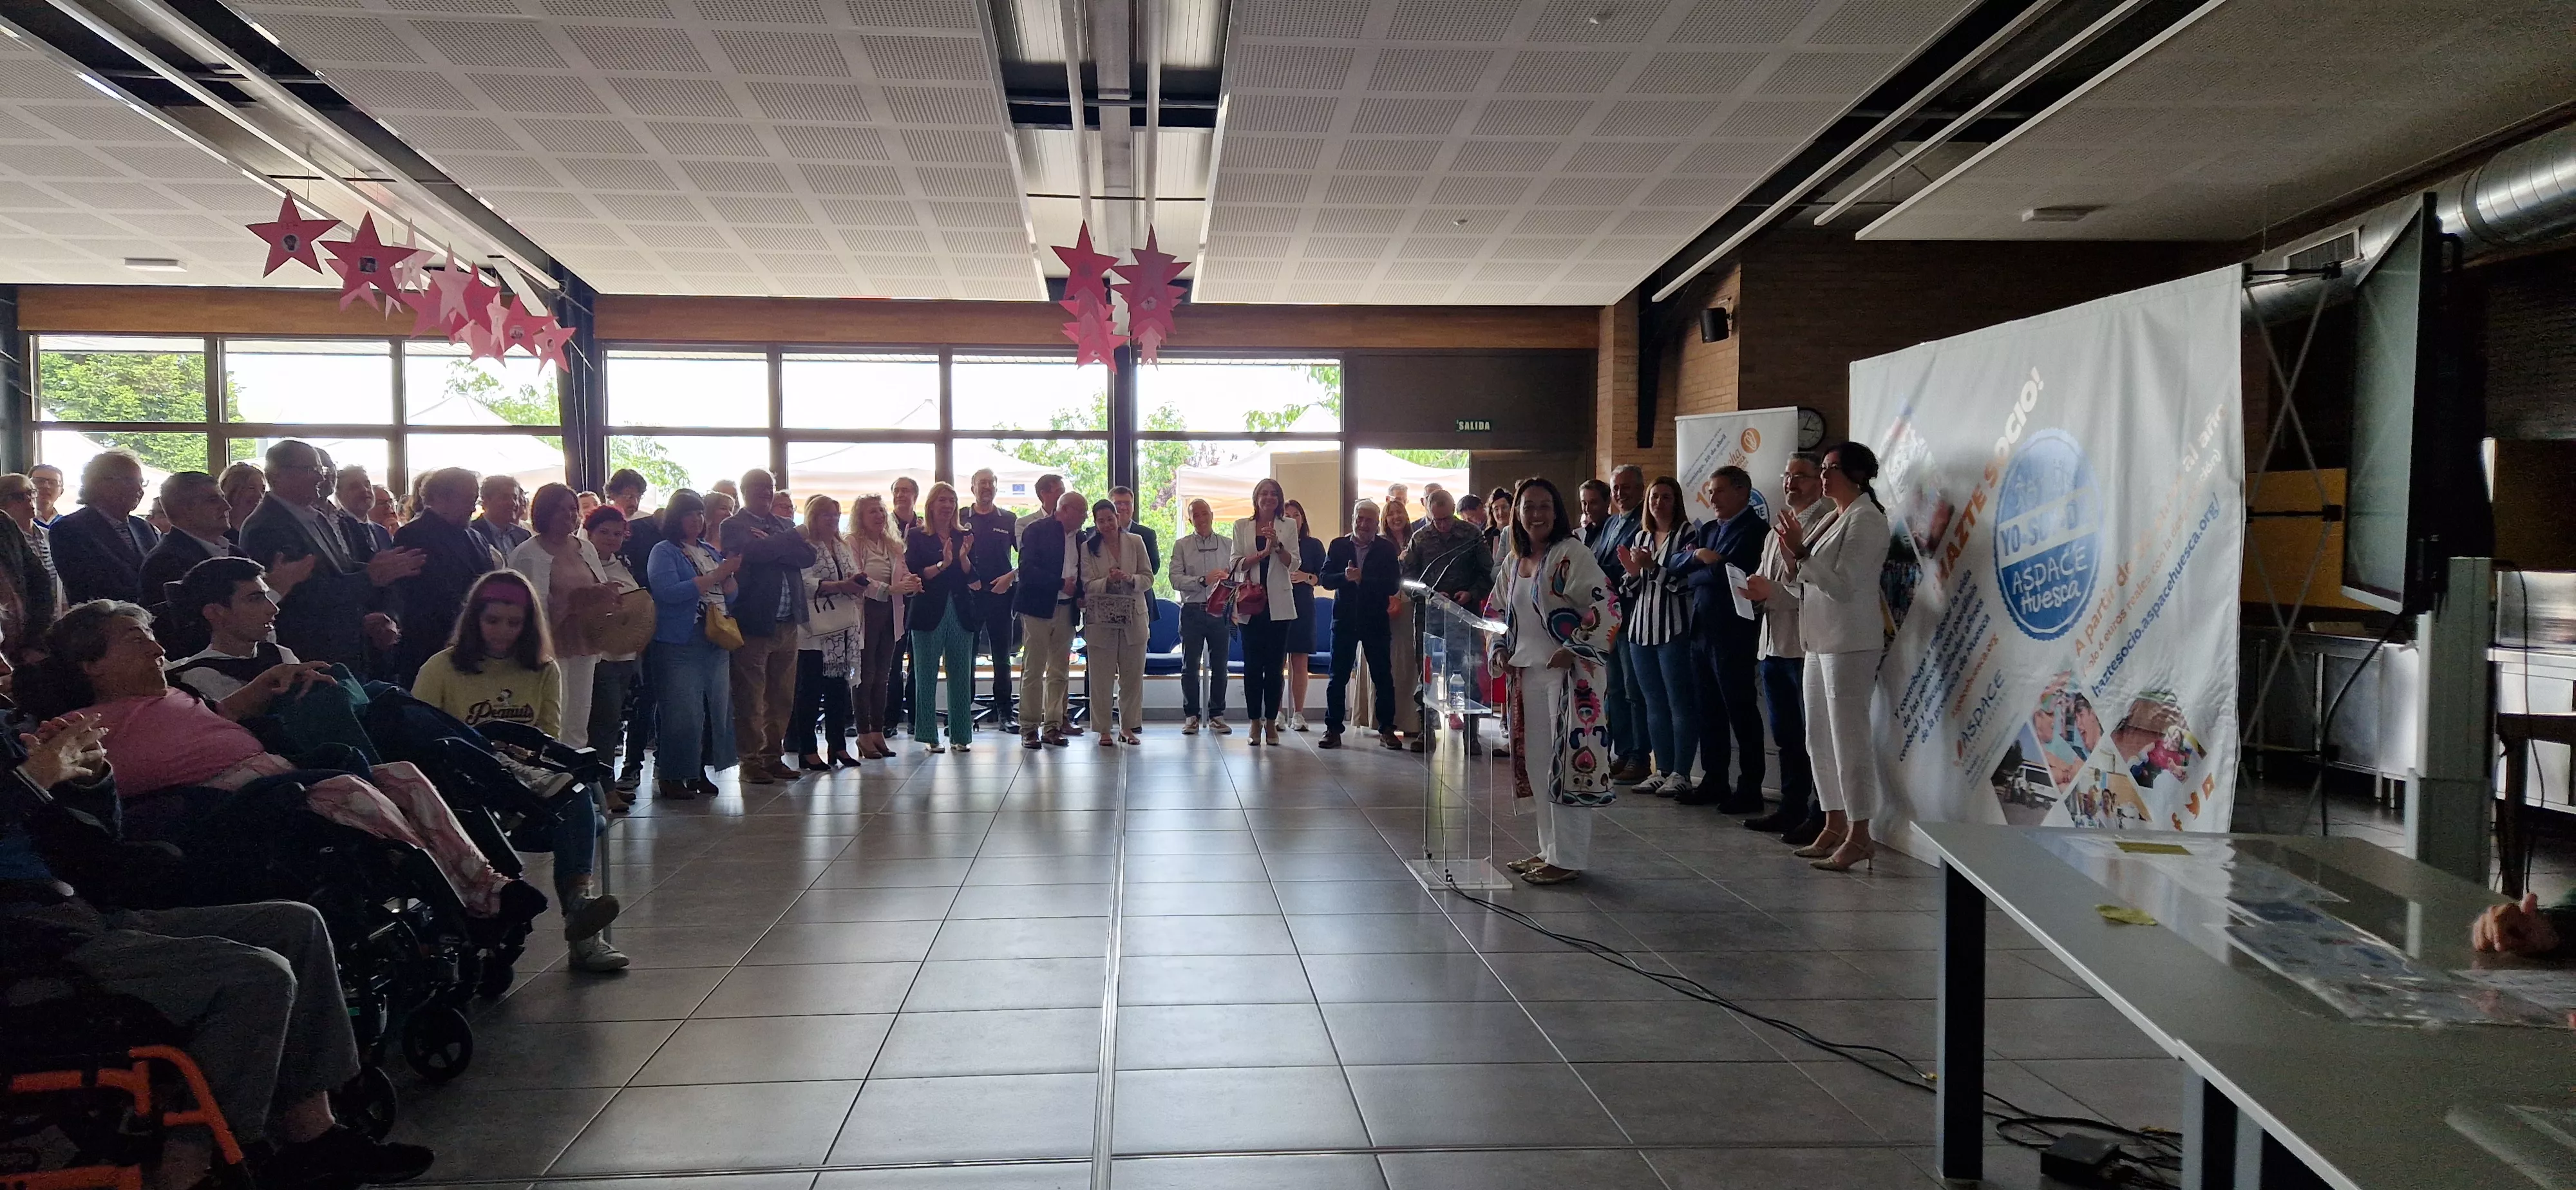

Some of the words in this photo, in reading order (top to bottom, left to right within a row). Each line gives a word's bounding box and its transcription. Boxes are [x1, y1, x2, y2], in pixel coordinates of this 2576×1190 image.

[1459, 421, 1490, 430] SALIDA
[1710, 448, 1717, 456] de
[1716, 433, 1727, 448] abril
[1984, 366, 2044, 489] SOCIO!
[2183, 442, 2199, 473] al
[2012, 545, 2088, 595] ASPACE
[2020, 580, 2081, 615] Huesca
[2098, 641, 2105, 652] 6
[2103, 608, 2128, 643] euros
[2126, 574, 2152, 610] reales
[2151, 550, 2166, 576] con
[2075, 638, 2086, 657] A
[2085, 587, 2116, 645] partir
[1903, 713, 1911, 728] de
[1909, 697, 1920, 715] las
[1961, 668, 2005, 749] ASPACE
